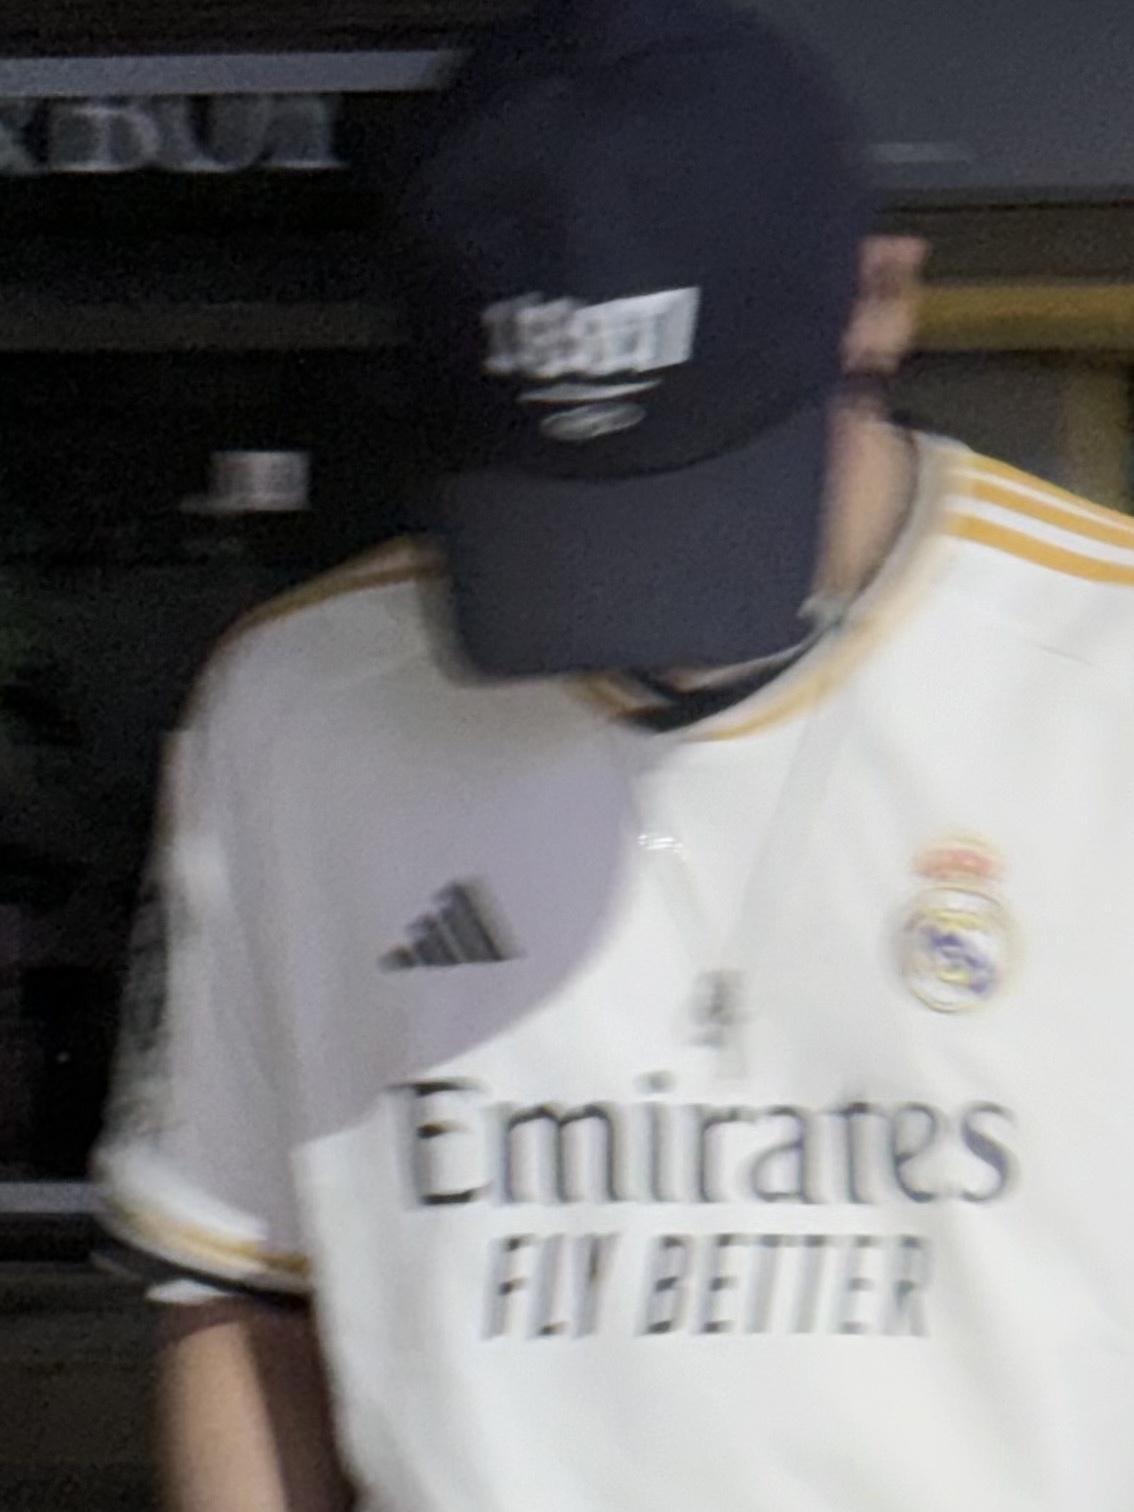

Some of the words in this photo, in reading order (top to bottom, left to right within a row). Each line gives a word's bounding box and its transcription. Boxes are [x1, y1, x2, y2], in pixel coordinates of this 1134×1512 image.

[392, 1073, 1017, 1206] Emirates
[484, 1233, 618, 1340] FLY
[636, 1233, 932, 1340] BETTER
